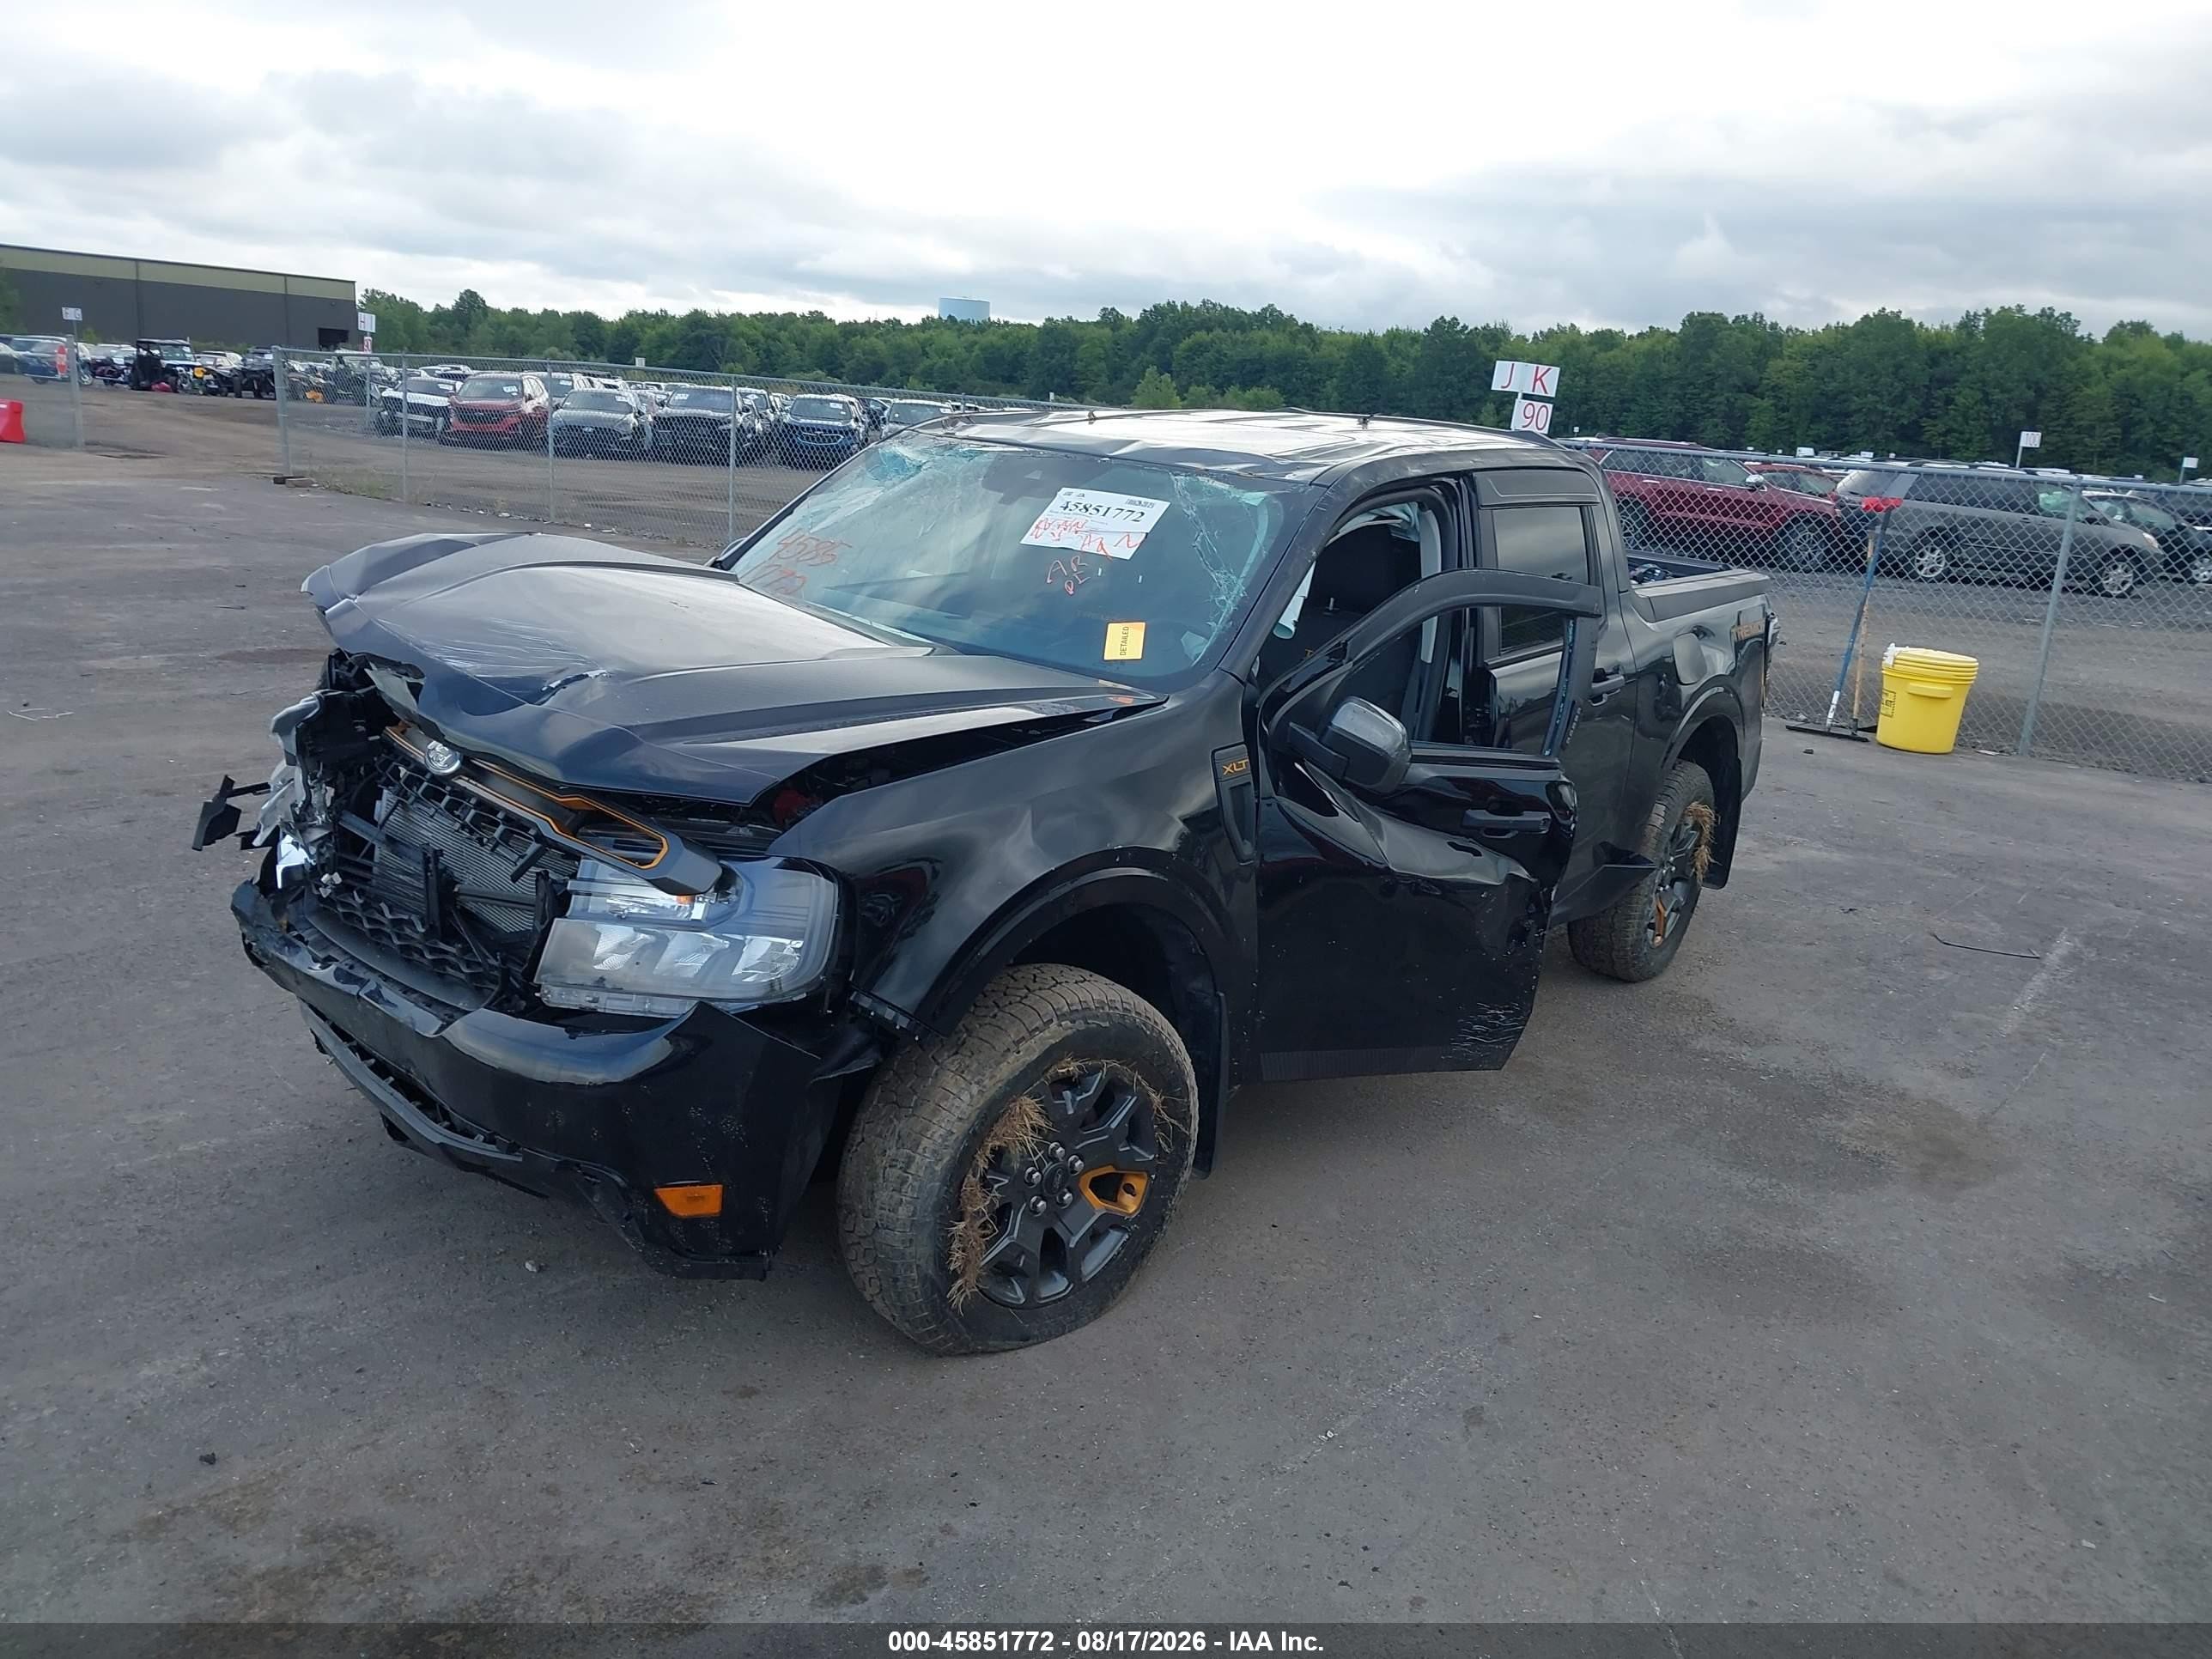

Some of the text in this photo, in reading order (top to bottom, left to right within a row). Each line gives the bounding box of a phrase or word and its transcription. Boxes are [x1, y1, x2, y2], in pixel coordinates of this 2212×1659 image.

[1500, 362, 1552, 394] J K
[1522, 402, 1549, 430] 90
[1059, 501, 1146, 522] 45851772
[1119, 626, 1129, 656] DETAILED
[1222, 758, 1249, 775] XLT
